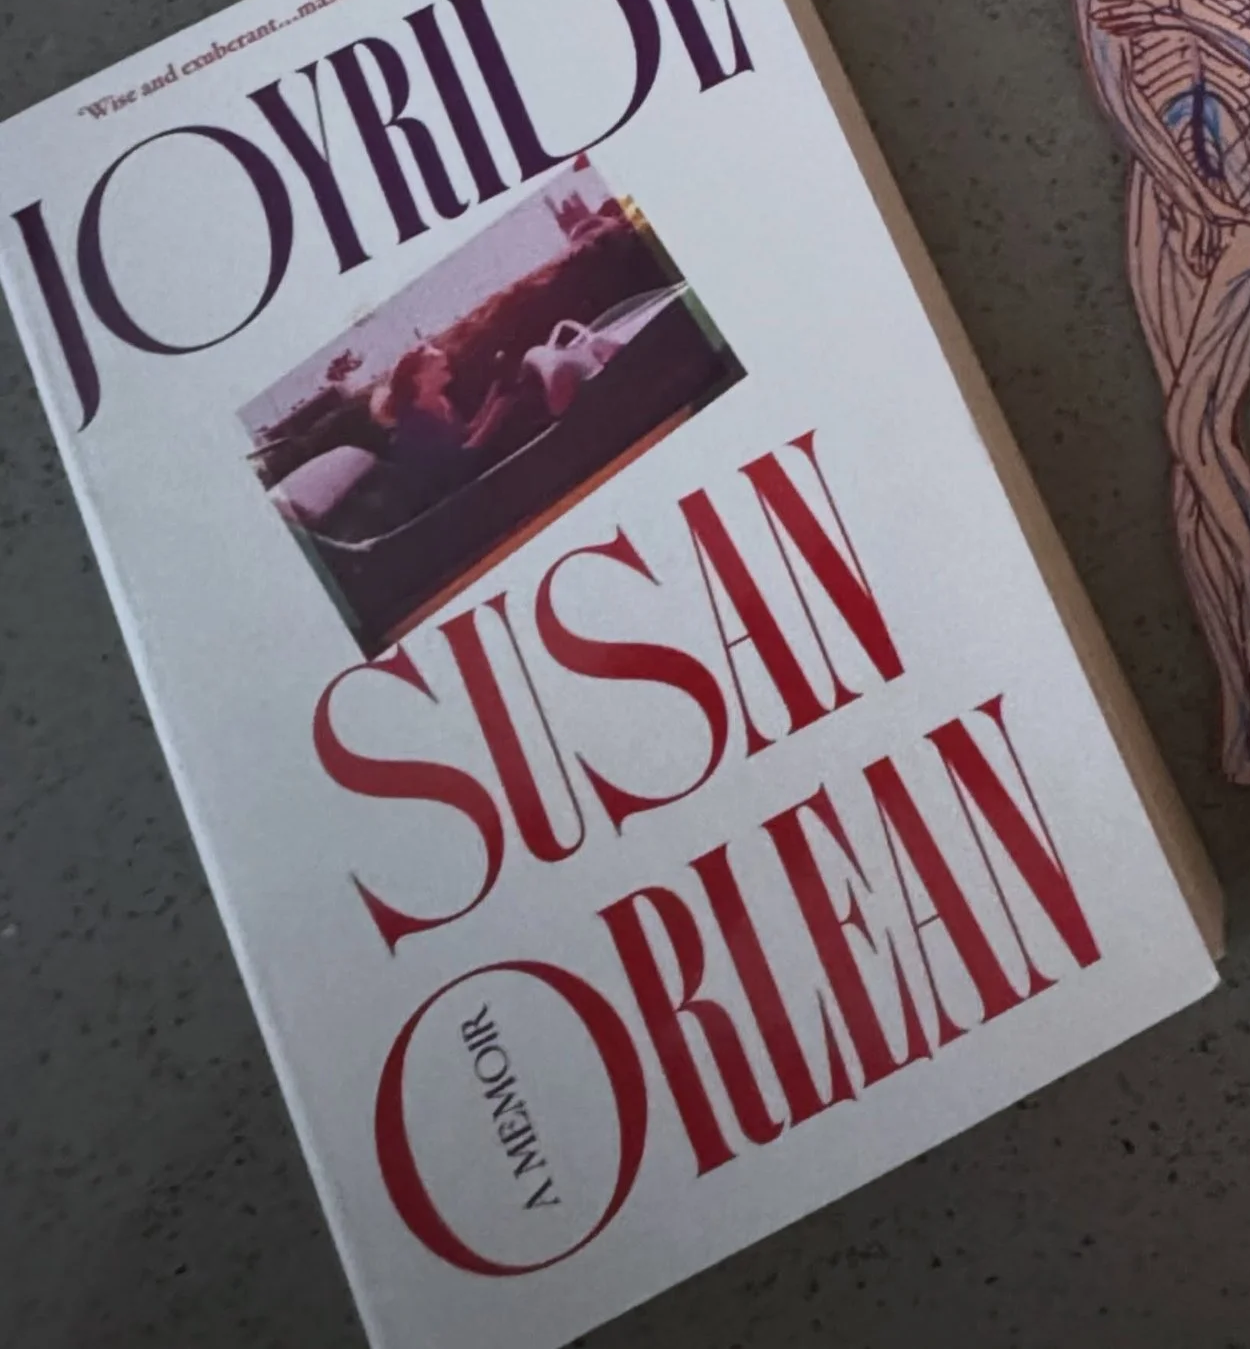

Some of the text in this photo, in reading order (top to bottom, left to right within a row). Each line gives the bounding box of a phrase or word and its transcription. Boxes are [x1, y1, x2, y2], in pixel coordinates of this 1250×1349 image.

[141, 63, 179, 97] and
[311, 428, 908, 960] SUSAN
[373, 692, 1103, 1279] ORLEAN
[459, 1000, 563, 1211] A MEMOIR
